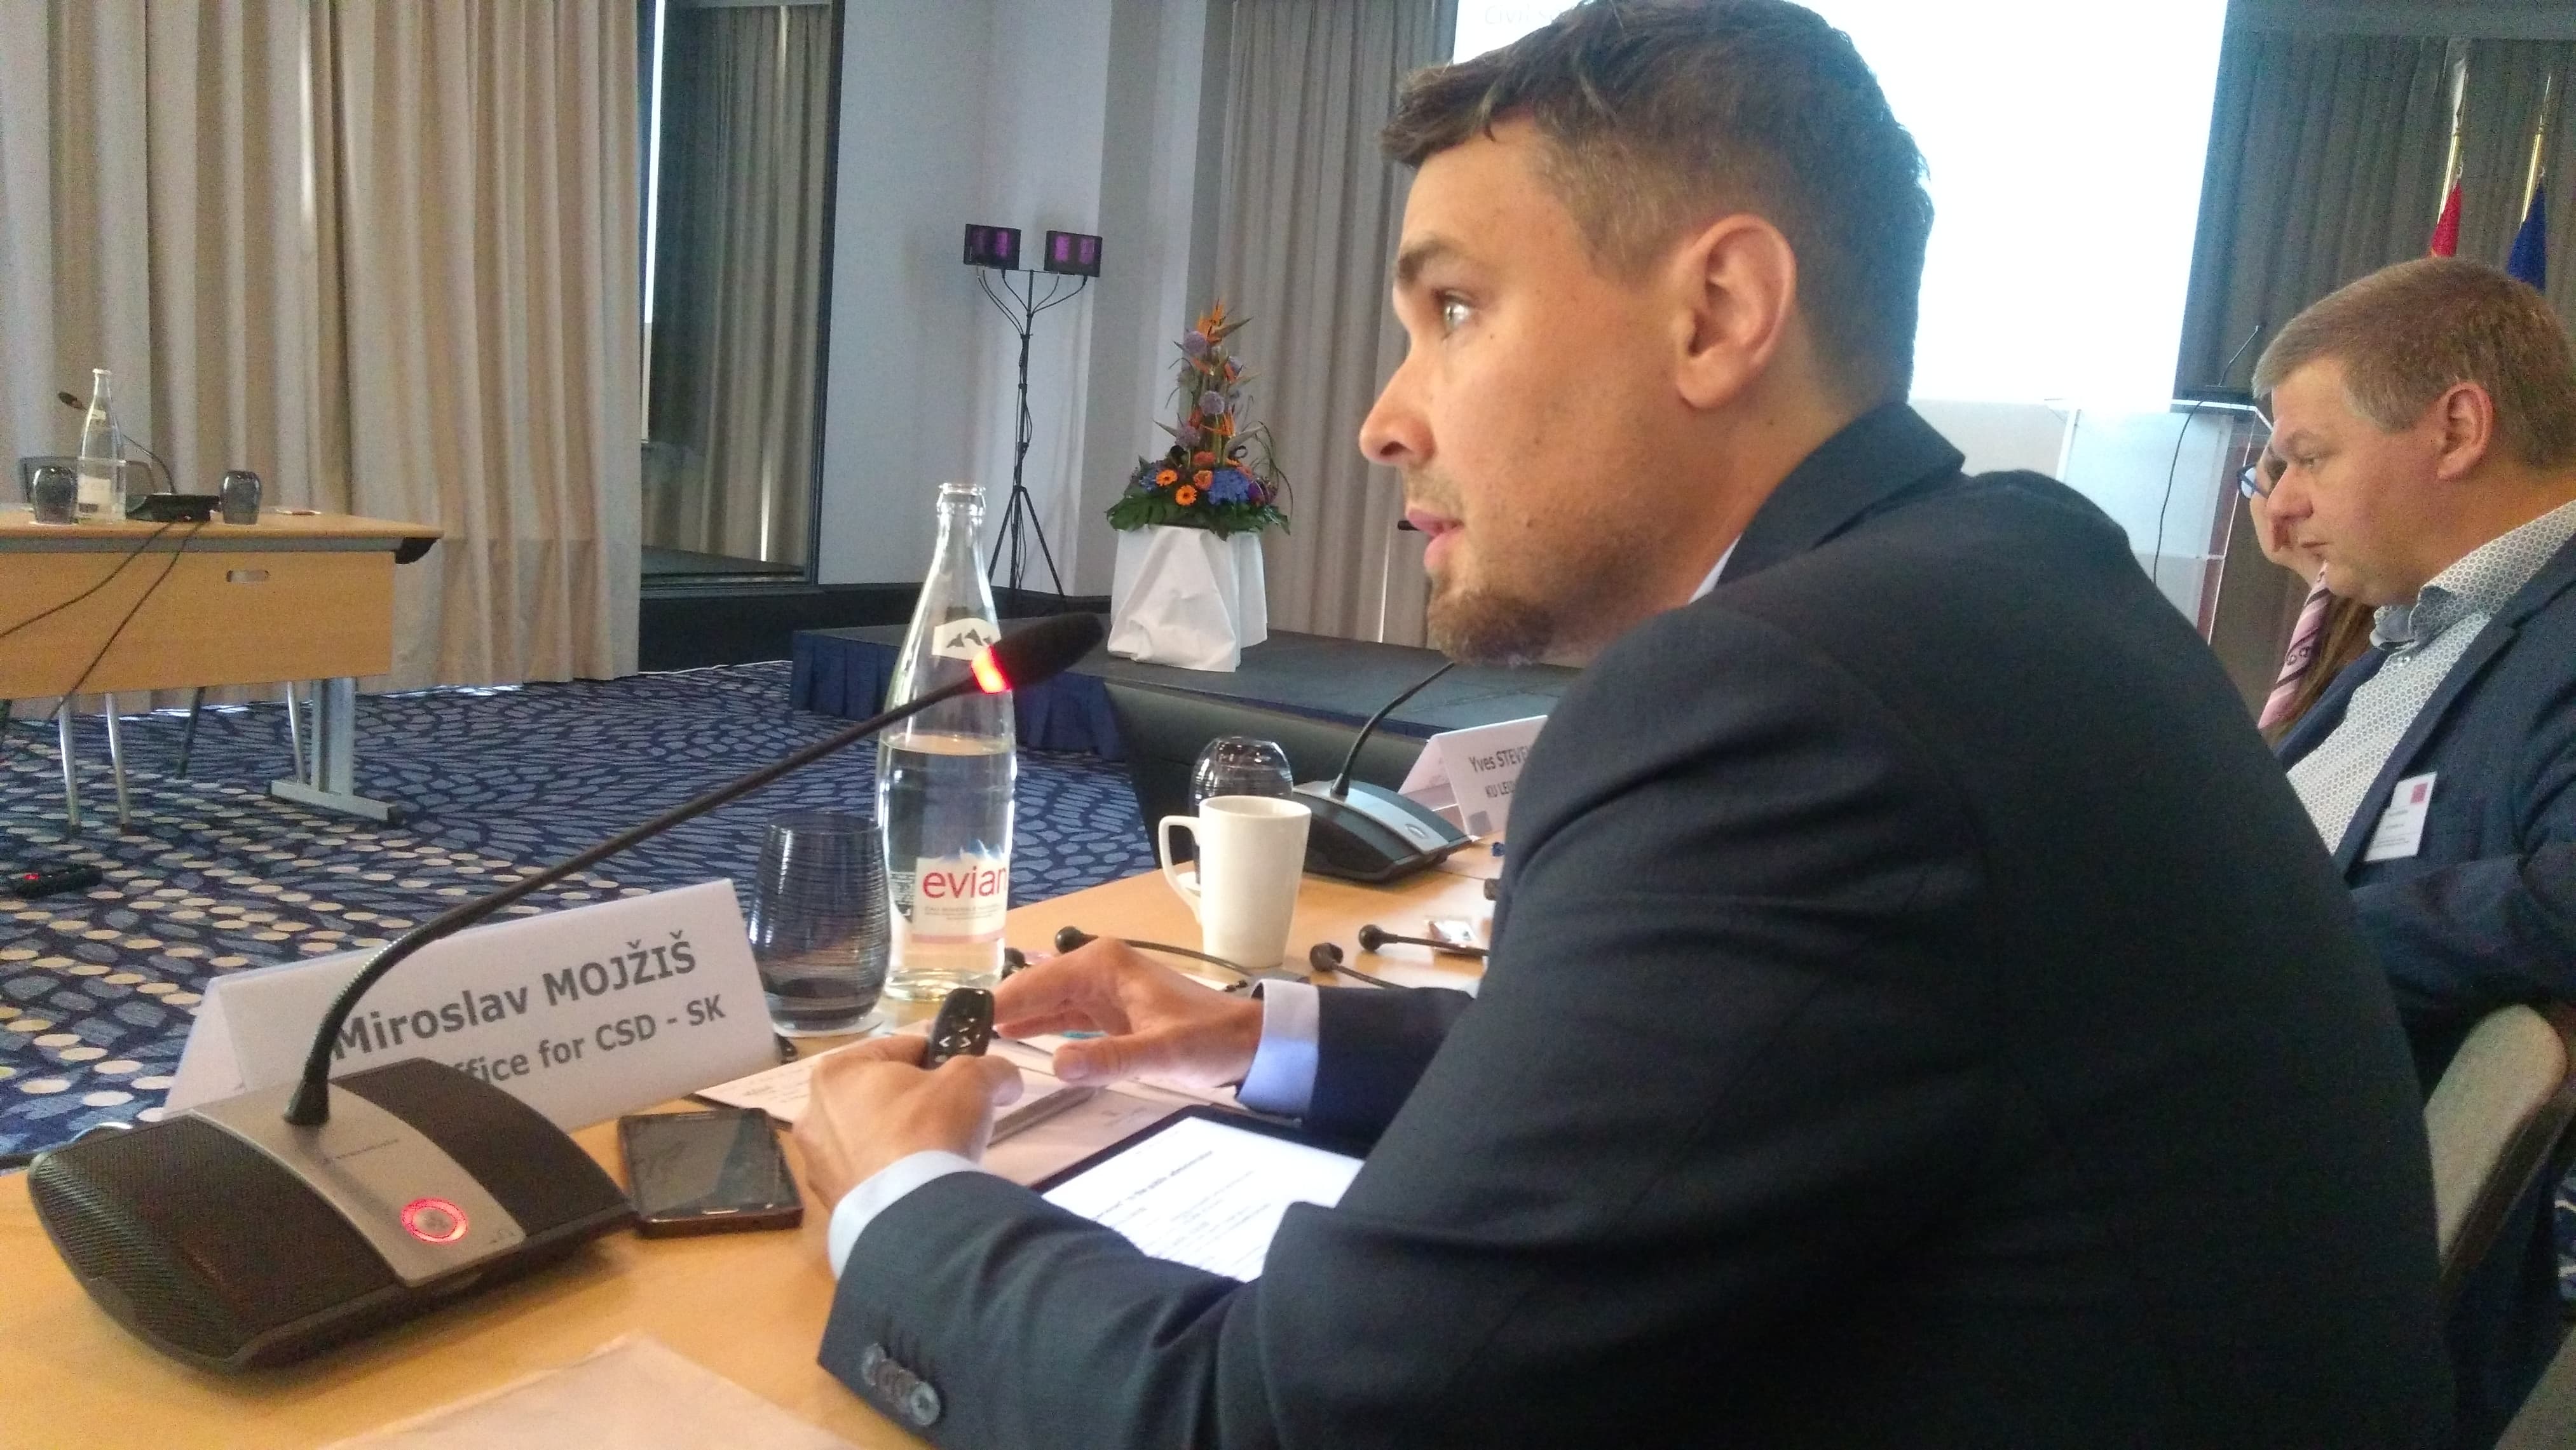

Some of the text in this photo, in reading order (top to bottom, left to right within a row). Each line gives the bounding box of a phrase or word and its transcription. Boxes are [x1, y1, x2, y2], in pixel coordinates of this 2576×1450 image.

[1469, 755, 1496, 772] Yves
[331, 930, 696, 1060] Miroslav MOJŽIŠ
[453, 1055, 531, 1081] ffice
[538, 1039, 585, 1068] for
[595, 1014, 657, 1052] CSD
[686, 993, 726, 1027] SK
